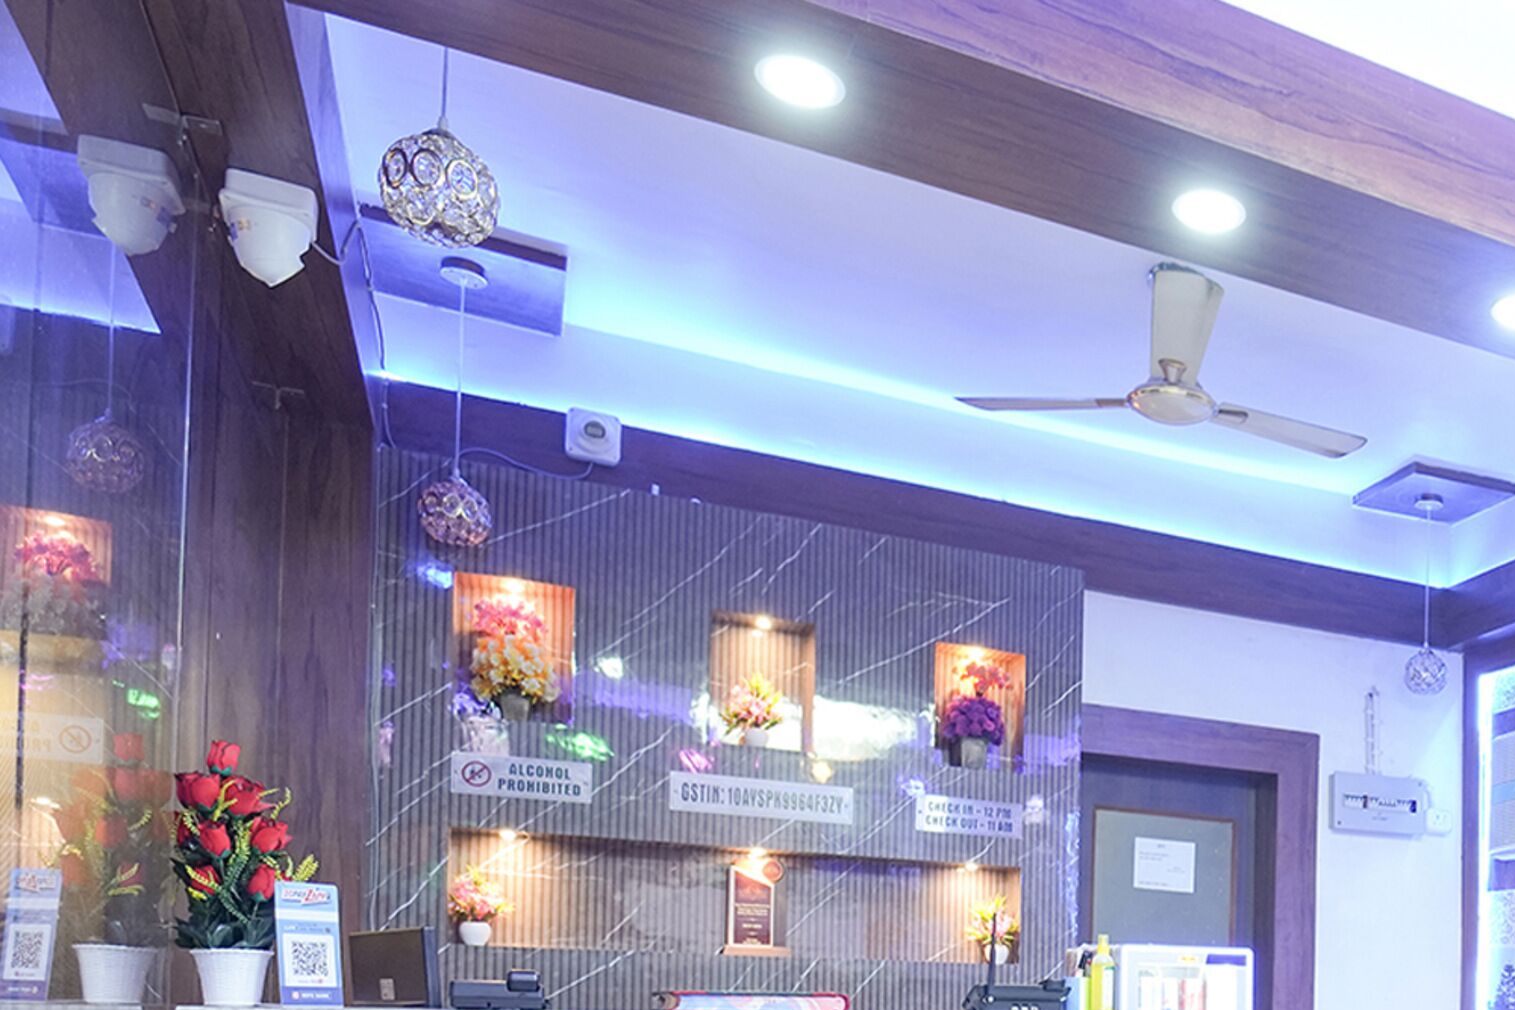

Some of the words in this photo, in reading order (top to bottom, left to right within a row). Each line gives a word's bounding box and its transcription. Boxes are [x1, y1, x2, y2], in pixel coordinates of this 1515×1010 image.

[508, 763, 571, 780] ALCOHOL
[497, 778, 582, 797] PROHIBITED
[928, 801, 961, 814] CHECK
[962, 804, 974, 815] IN
[984, 806, 994, 818] 12
[996, 807, 1012, 819] PM
[925, 814, 958, 827] CHECK
[960, 818, 978, 829] OUT
[998, 821, 1013, 833] AM
